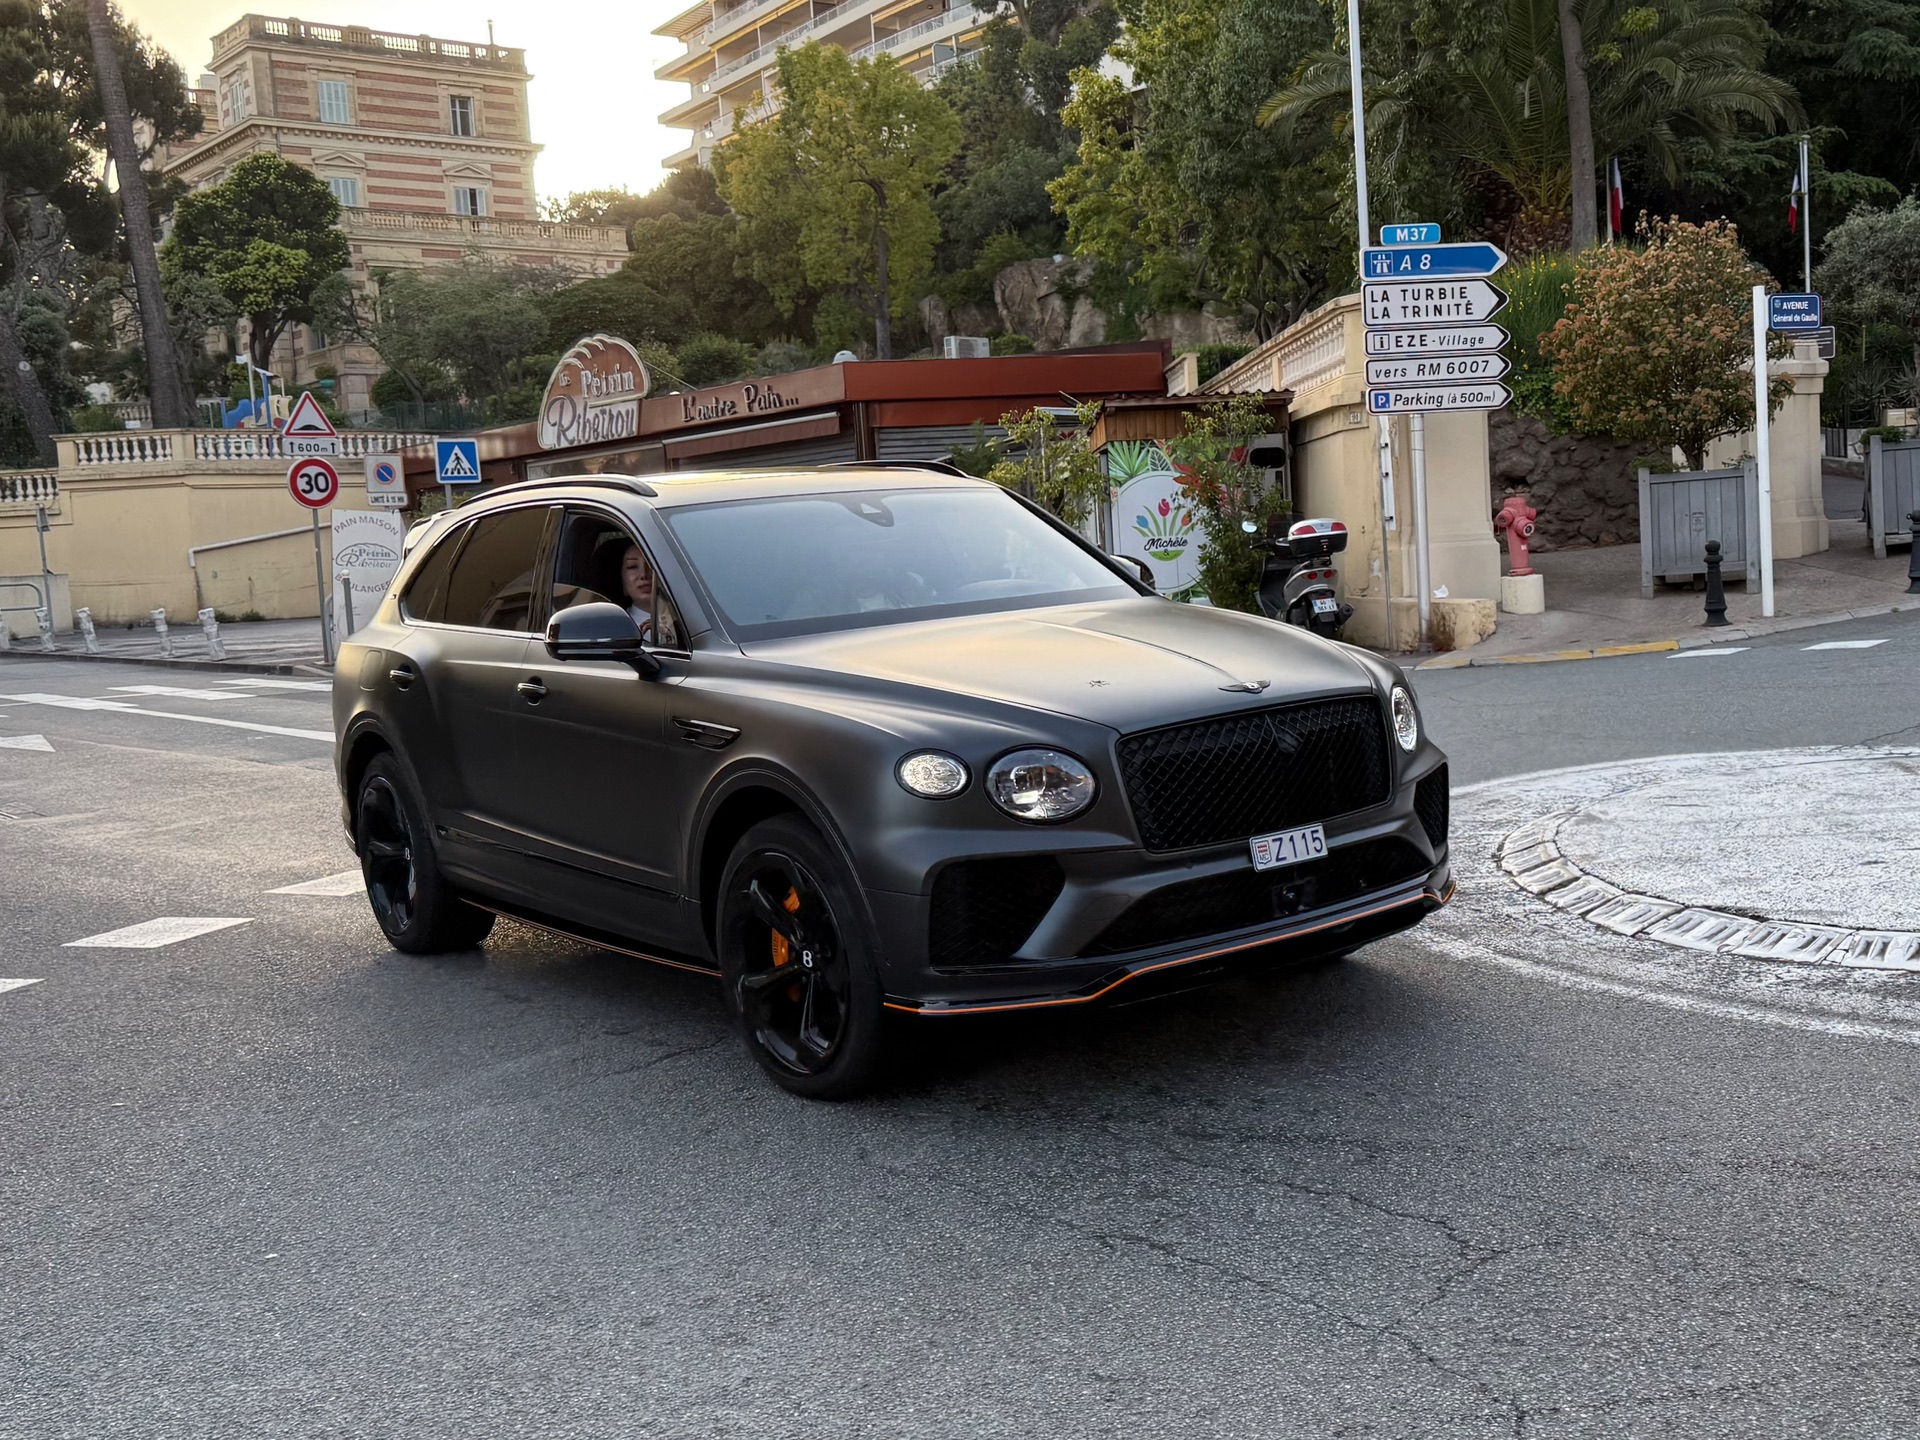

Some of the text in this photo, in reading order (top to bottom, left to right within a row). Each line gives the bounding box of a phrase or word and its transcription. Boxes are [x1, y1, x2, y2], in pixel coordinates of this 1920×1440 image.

[1396, 227, 1428, 242] M37
[1400, 254, 1432, 271] A 8
[1370, 286, 1468, 303] LA TURBIE
[1371, 300, 1474, 319] LA TRINITÉ
[1782, 301, 1809, 310] AVENUE
[1773, 313, 1818, 323] Général de Gaulle
[1375, 360, 1490, 379] vers RM 6007
[1393, 392, 1444, 408] Parking
[299, 472, 330, 494] 30
[333, 516, 399, 536] PAIN MAISON
[1143, 536, 1189, 551] Michèle
[1271, 829, 1324, 863] Z115
